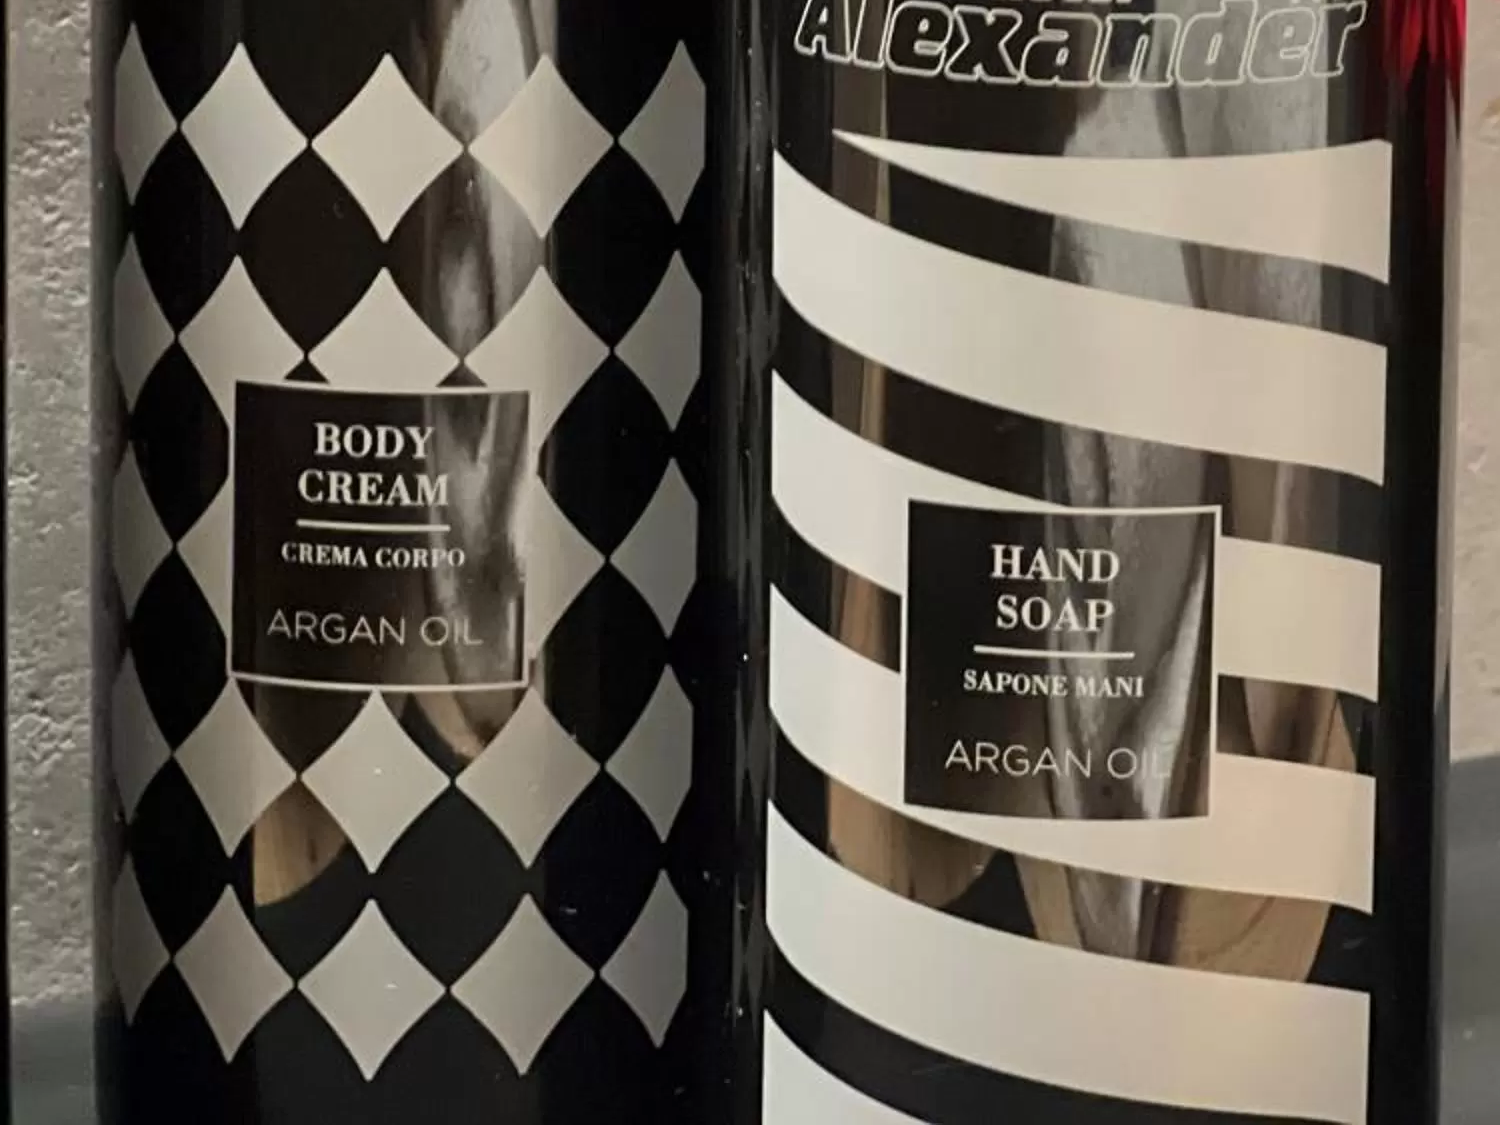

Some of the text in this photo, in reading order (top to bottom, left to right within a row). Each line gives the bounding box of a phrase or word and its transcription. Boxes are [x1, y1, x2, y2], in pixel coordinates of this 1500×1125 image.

[314, 421, 435, 460] BODY
[297, 468, 449, 507] CREAM
[280, 540, 466, 569] CREMA CORPO
[990, 544, 1120, 583] HAND
[266, 608, 485, 647] ARGAN OIL
[995, 594, 1115, 632] SOAP
[963, 669, 1145, 698] SAPONE MANI
[944, 739, 1092, 779] ARGAN
